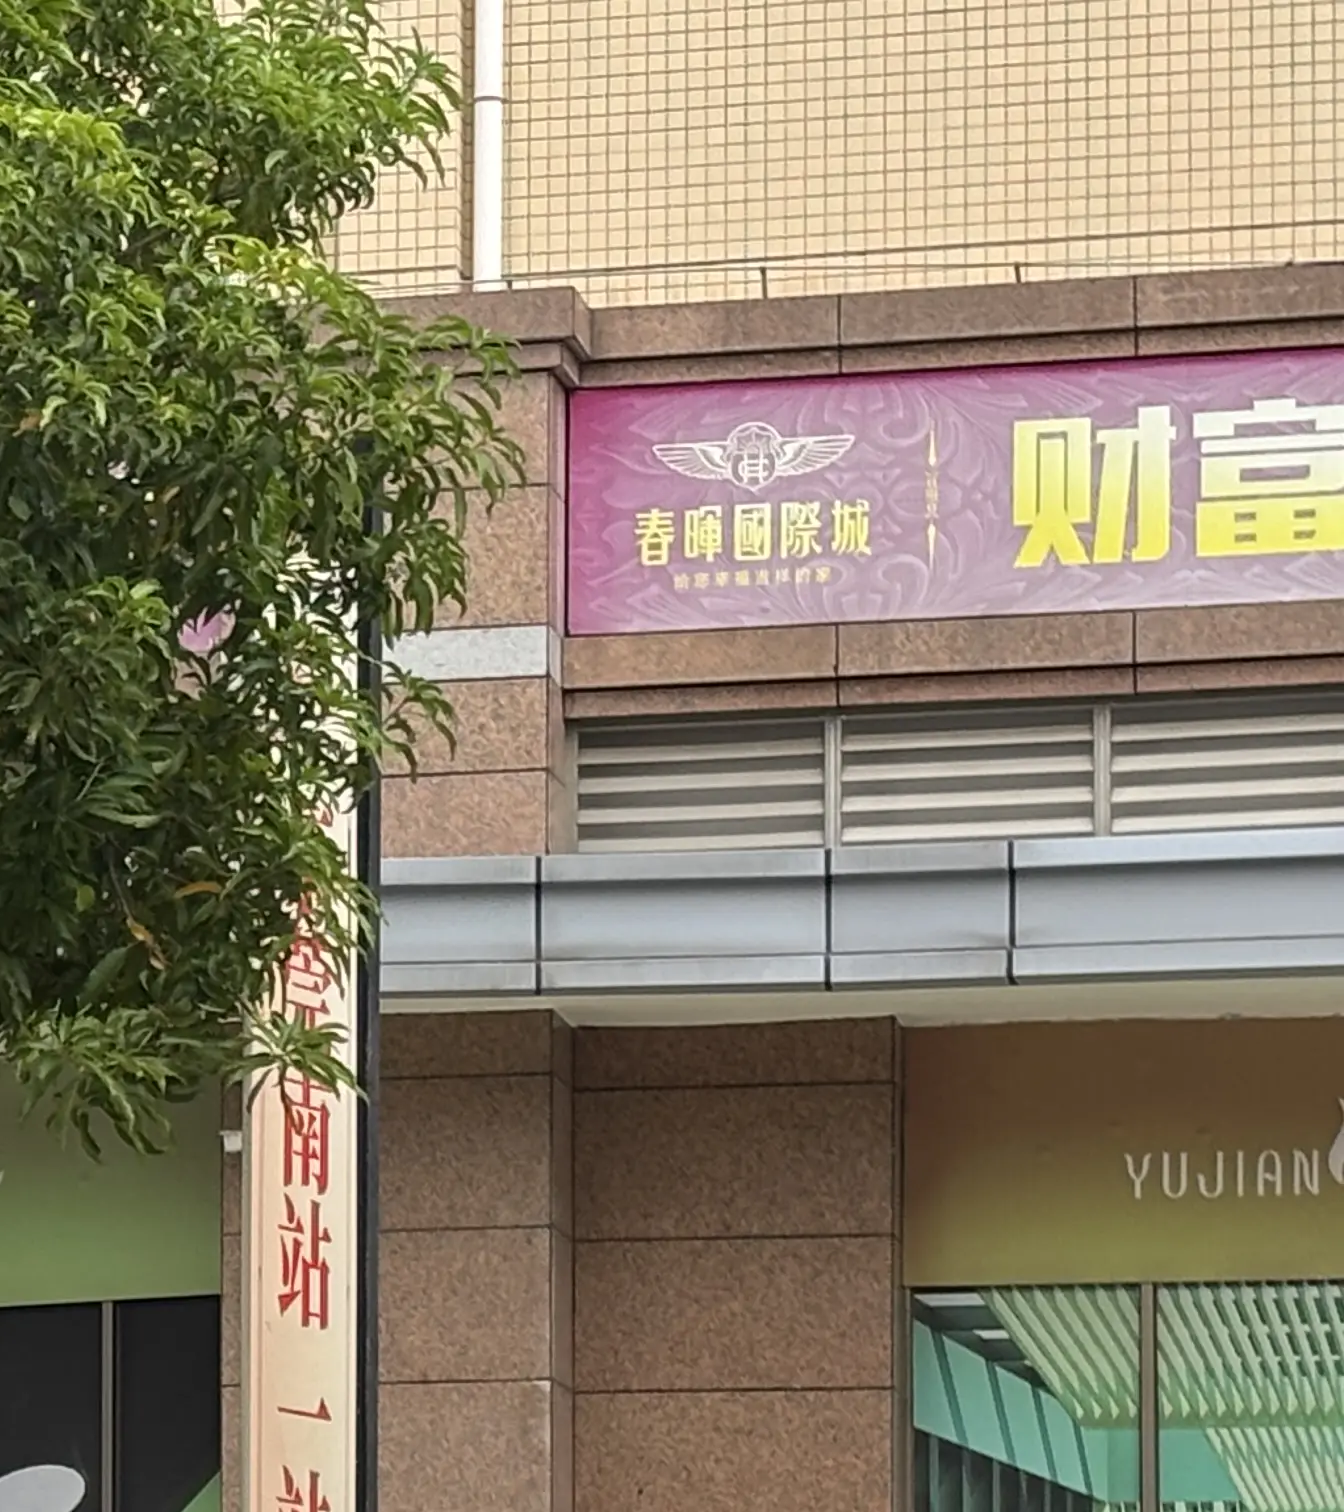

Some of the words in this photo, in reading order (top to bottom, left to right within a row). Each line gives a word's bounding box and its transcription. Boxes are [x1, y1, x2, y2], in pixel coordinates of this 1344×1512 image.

[1014, 398, 1344, 569] 财富
[634, 499, 872, 566] 春暉國際城
[1124, 1149, 1320, 1200] YUJIAN
